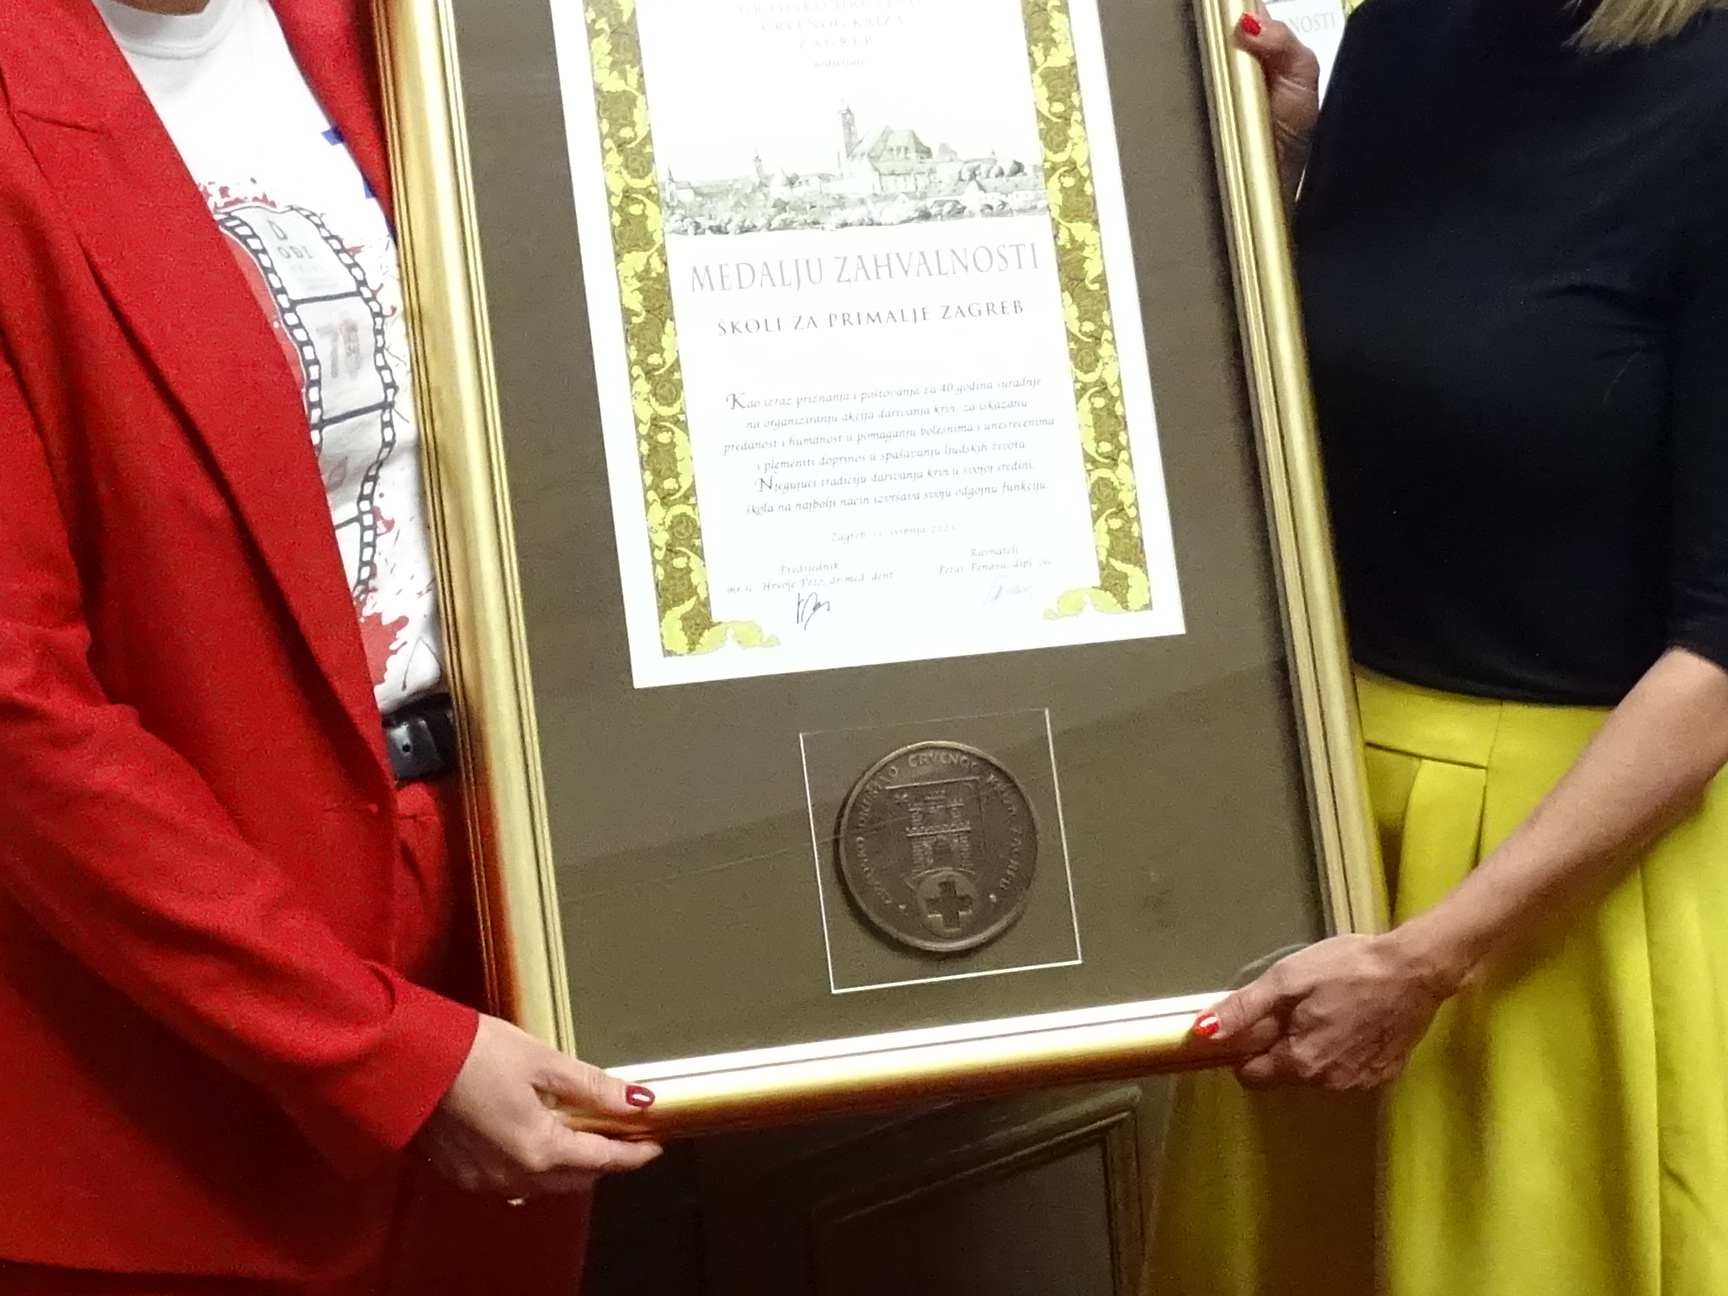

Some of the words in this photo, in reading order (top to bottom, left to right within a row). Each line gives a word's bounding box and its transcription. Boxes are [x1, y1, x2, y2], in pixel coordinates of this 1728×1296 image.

[761, 18, 846, 33] CRVENOG
[690, 256, 824, 294] MEDALJU
[833, 242, 1040, 285] ZAHVALNOSTI
[716, 316, 782, 337] ŠKOLI
[791, 314, 819, 331] ZA
[828, 306, 930, 329] PRIMALJE
[940, 299, 1025, 320] ZAGREB
[725, 392, 761, 411] Kao
[763, 396, 793, 408] izraz
[795, 392, 850, 409] priznanja
[859, 386, 920, 404] poštovanja
[941, 382, 954, 393] 40
[954, 379, 994, 396] godina
[996, 375, 1042, 390] suradnje
[746, 420, 760, 430] na
[763, 413, 838, 431] organiziranju
[841, 409, 875, 424] akcija
[877, 405, 931, 420] darivanja
[979, 397, 1028, 412] iskazanu
[723, 438, 778, 456] predanost
[788, 434, 843, 448] humanost
[856, 427, 916, 445] pomaganju
[920, 421, 974, 437] bolesnima
[764, 457, 815, 474] plemeniti
[818, 453, 866, 469] doprinos
[879, 447, 941, 464] spašavanju
[944, 440, 988, 457] ljudskih
[820, 473, 867, 488] tradiciju
[870, 469, 924, 484] darivanja
[927, 465, 949, 480] krvi
[962, 463, 994, 476] svojoj
[745, 501, 774, 516] škola
[794, 497, 837, 513] najbolji
[873, 489, 921, 505] izvršava
[923, 487, 952, 501] svoju
[954, 483, 998, 500] odgojnu
